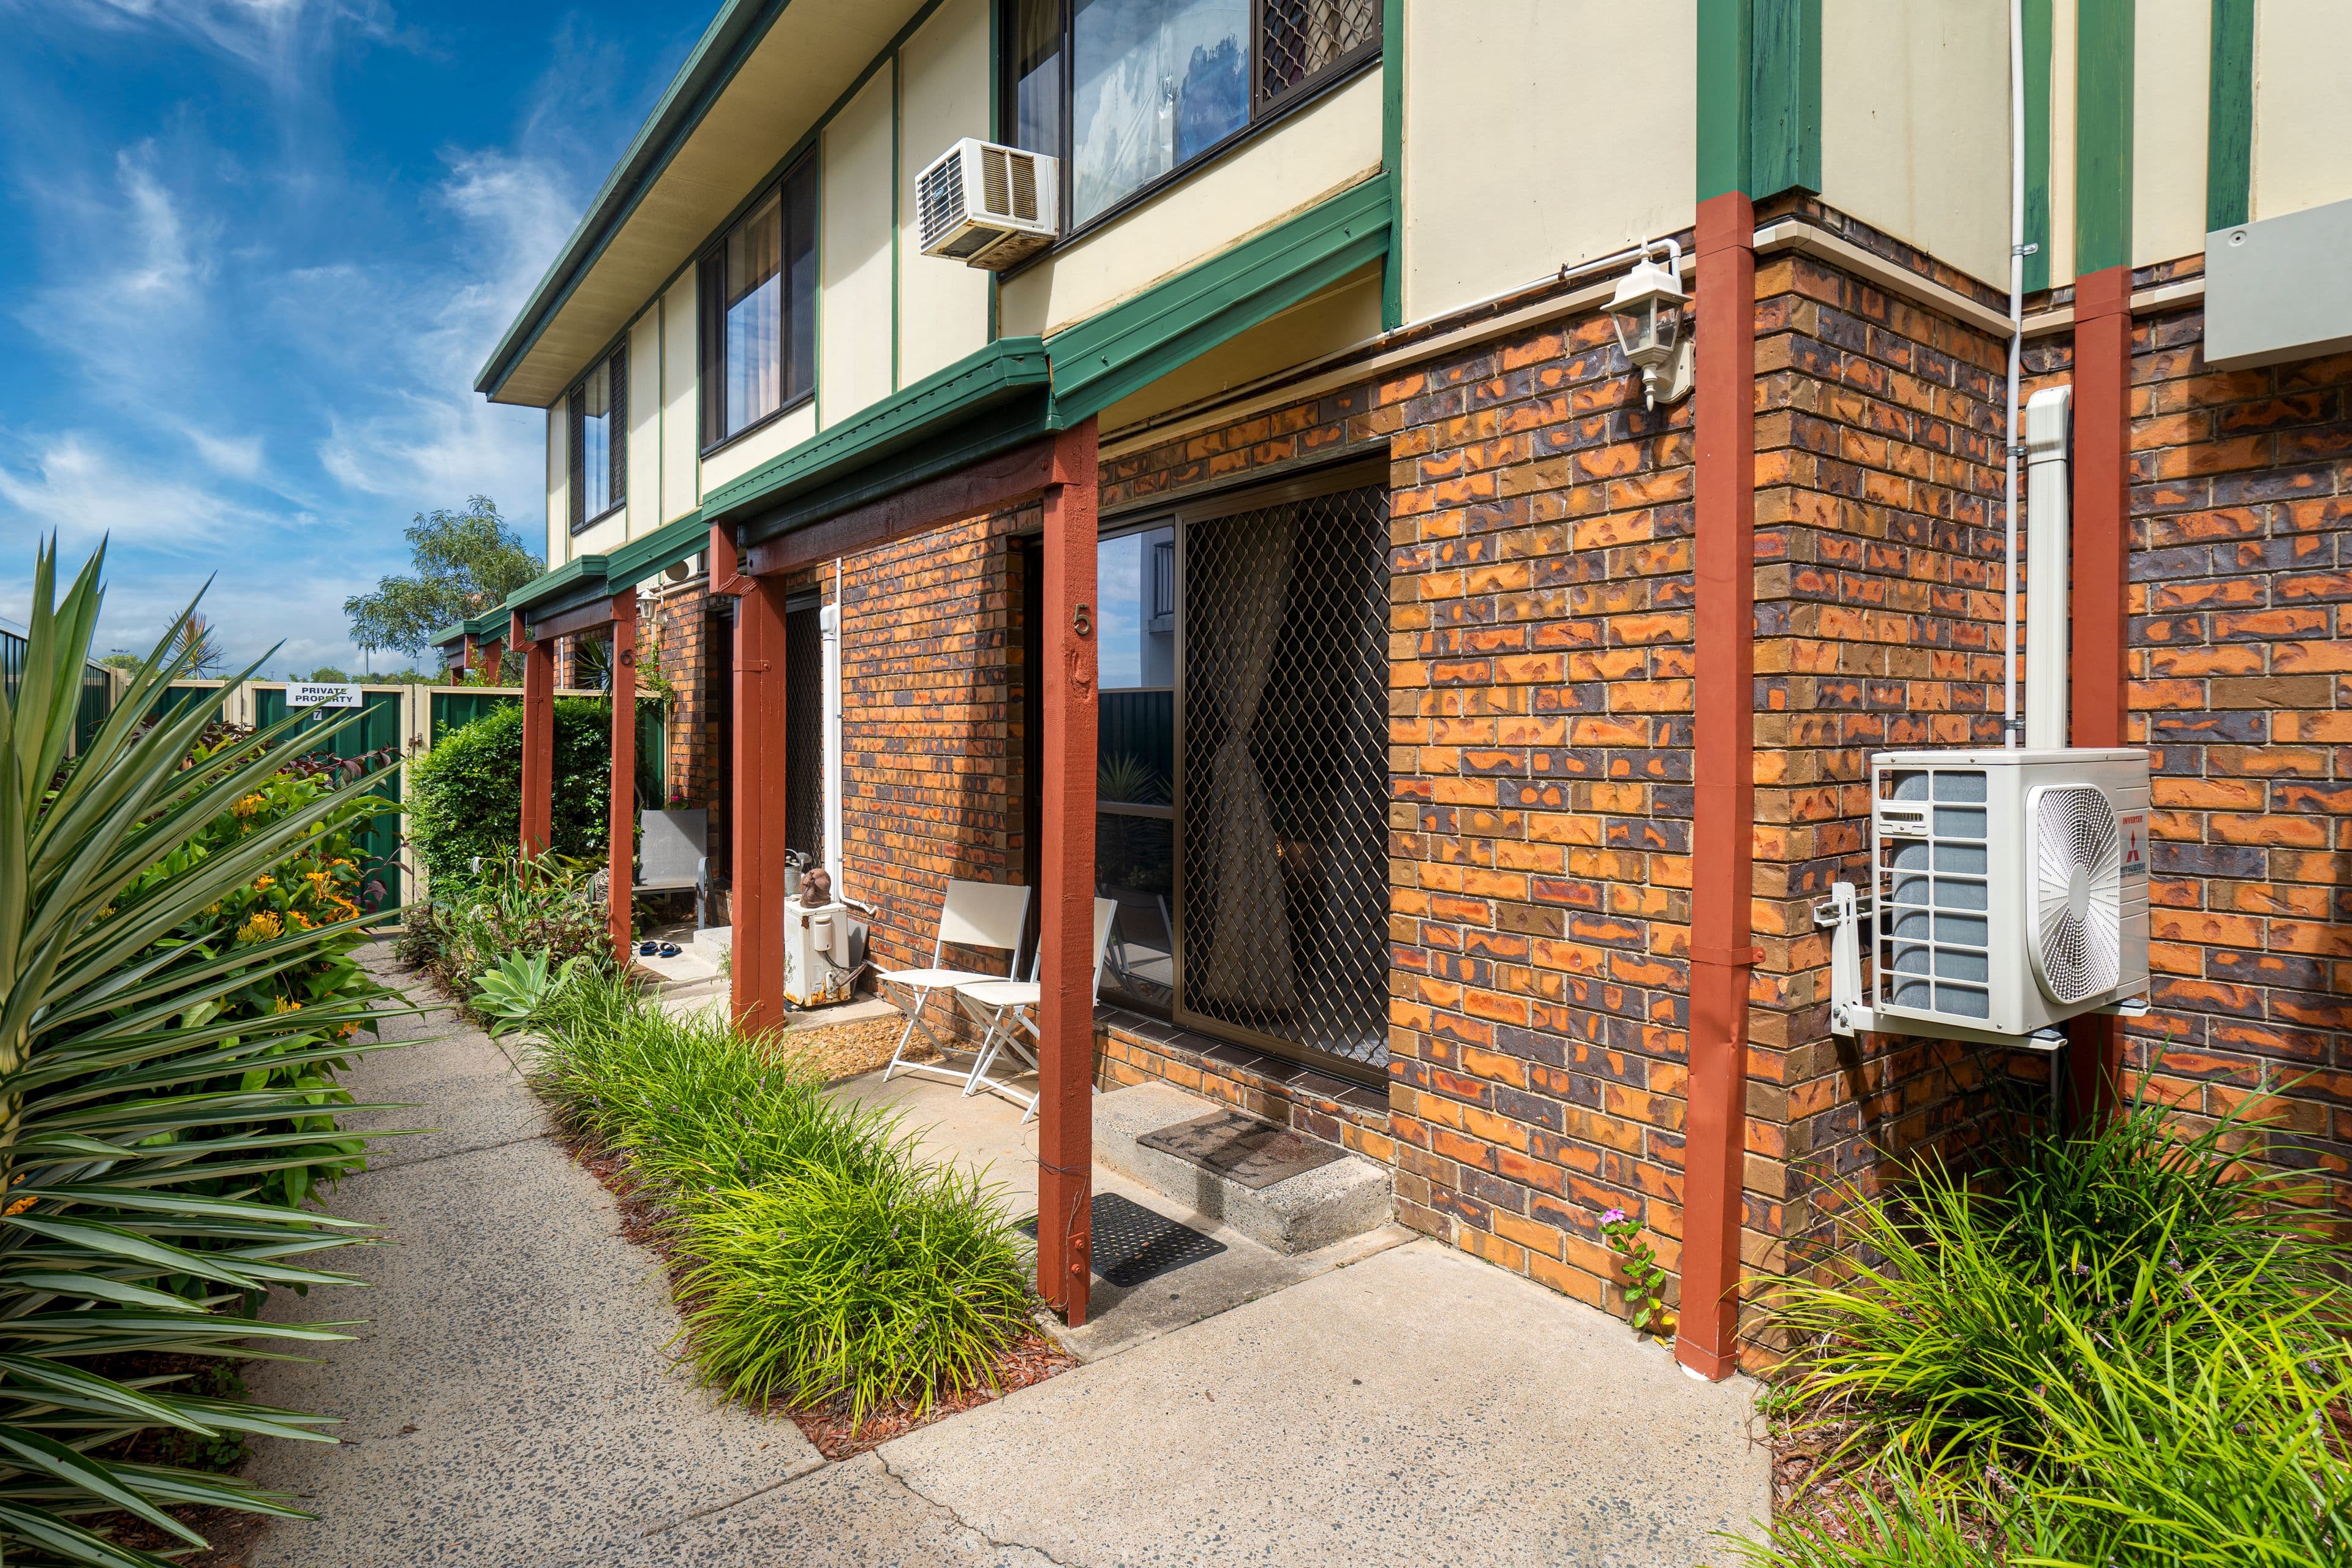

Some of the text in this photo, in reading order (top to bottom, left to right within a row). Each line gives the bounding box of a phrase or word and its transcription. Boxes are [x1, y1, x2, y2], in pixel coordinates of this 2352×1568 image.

[1074, 603, 1091, 635] 5
[620, 649, 633, 666] 6
[2122, 815, 2143, 825] INVERTER
